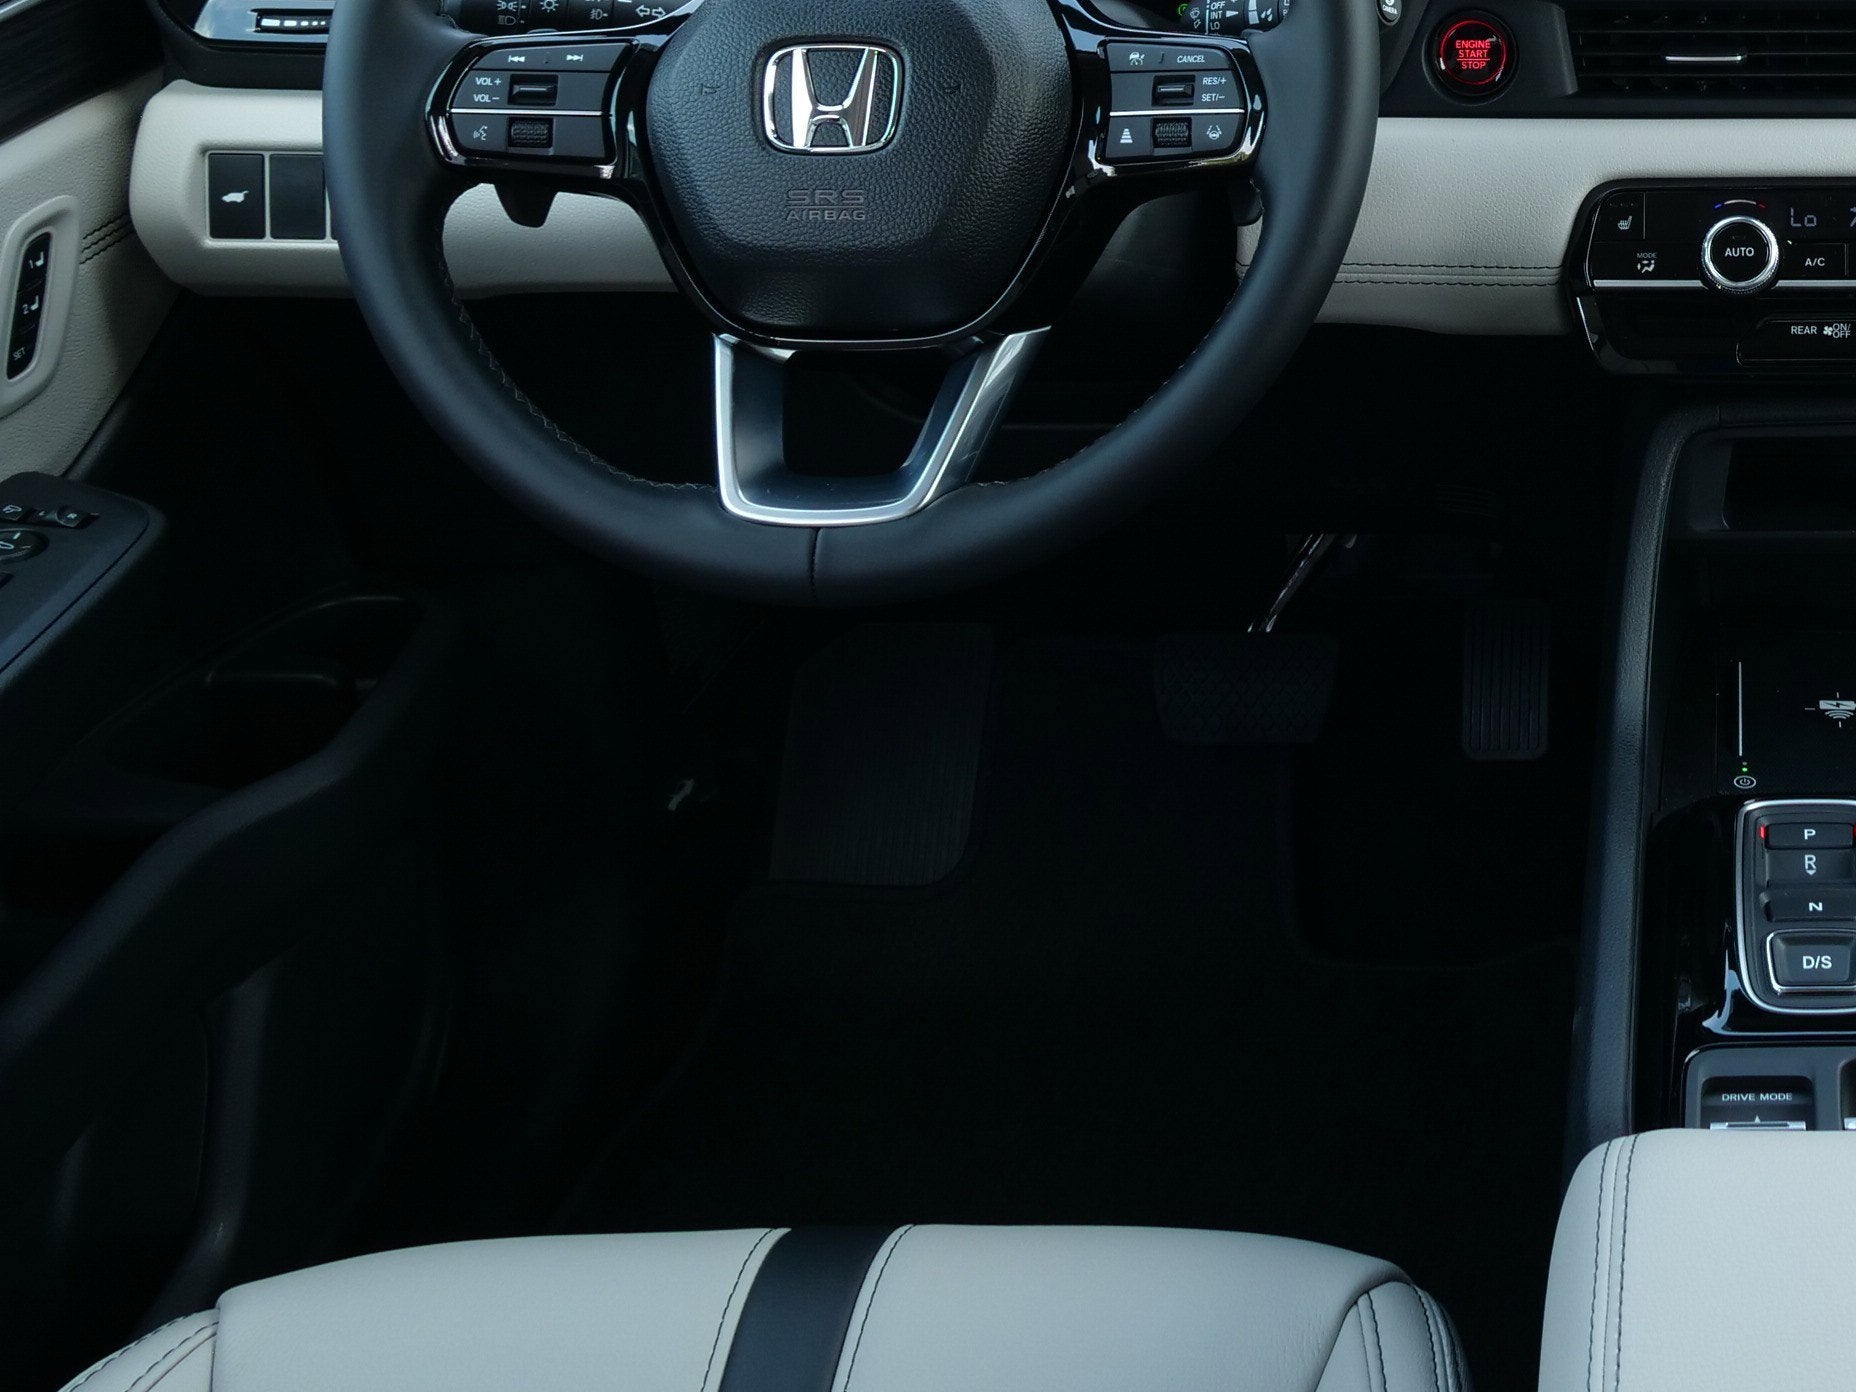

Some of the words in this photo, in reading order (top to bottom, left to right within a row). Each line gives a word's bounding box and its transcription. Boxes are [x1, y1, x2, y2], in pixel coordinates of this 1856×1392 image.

[1210, 0, 1226, 11] OFF
[1210, 10, 1223, 20] INT
[1209, 21, 1221, 31] LO
[1455, 39, 1490, 49] ENGINE
[1176, 54, 1206, 64] CANCEL
[1458, 49, 1488, 59] START
[1461, 59, 1487, 69] STOP
[1202, 76, 1227, 86] RES/+
[784, 188, 865, 207] SRS
[786, 209, 867, 222] AIRBAG
[1724, 246, 1755, 257] AUTO
[1804, 257, 1825, 267] A/C
[1790, 325, 1818, 335] REAR
[1832, 330, 1851, 339] OFF
[1803, 828, 1816, 840] P
[1804, 855, 1817, 869] R
[1808, 901, 1823, 912] N
[1802, 956, 1833, 969] D/S
[1721, 1093, 1756, 1102] DRIVE
[1759, 1093, 1793, 1101] MODE
